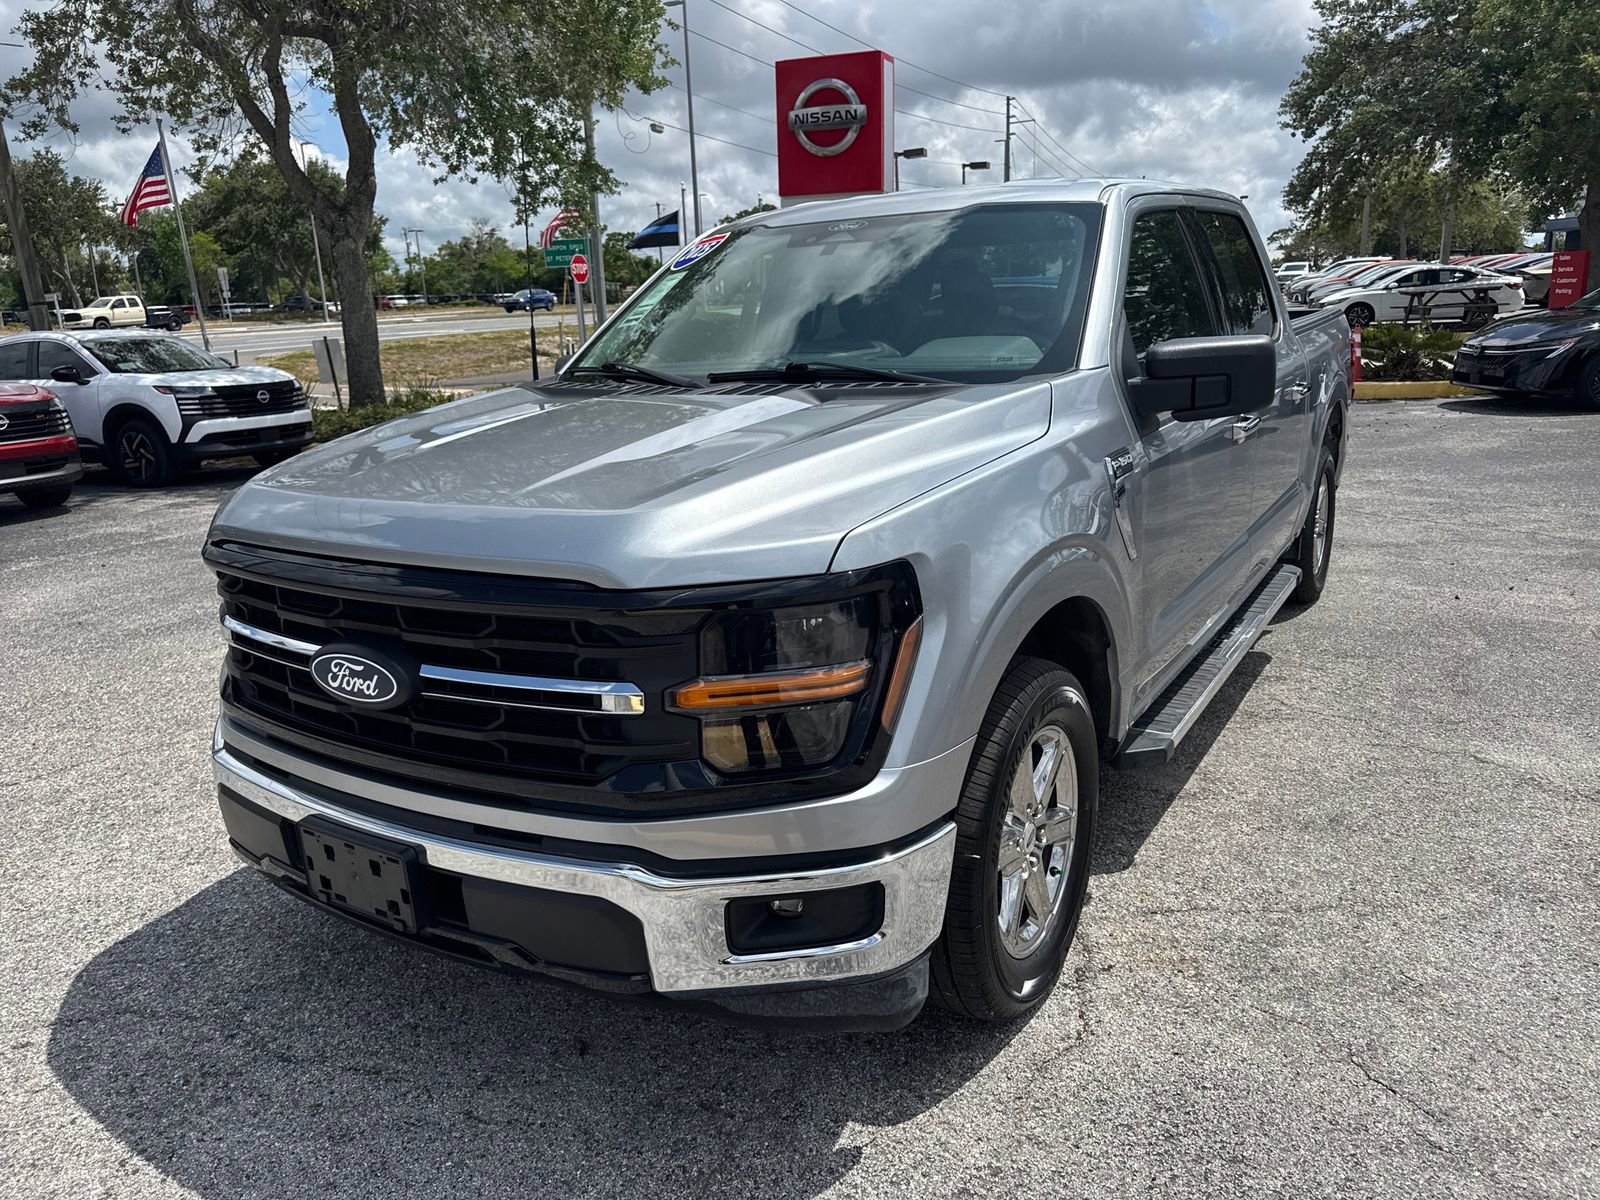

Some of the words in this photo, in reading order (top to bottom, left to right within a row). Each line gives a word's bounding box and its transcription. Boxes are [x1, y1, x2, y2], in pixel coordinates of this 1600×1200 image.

[794, 108, 858, 125] NISSAN
[572, 263, 587, 274] STOP
[327, 659, 379, 696] Ford
